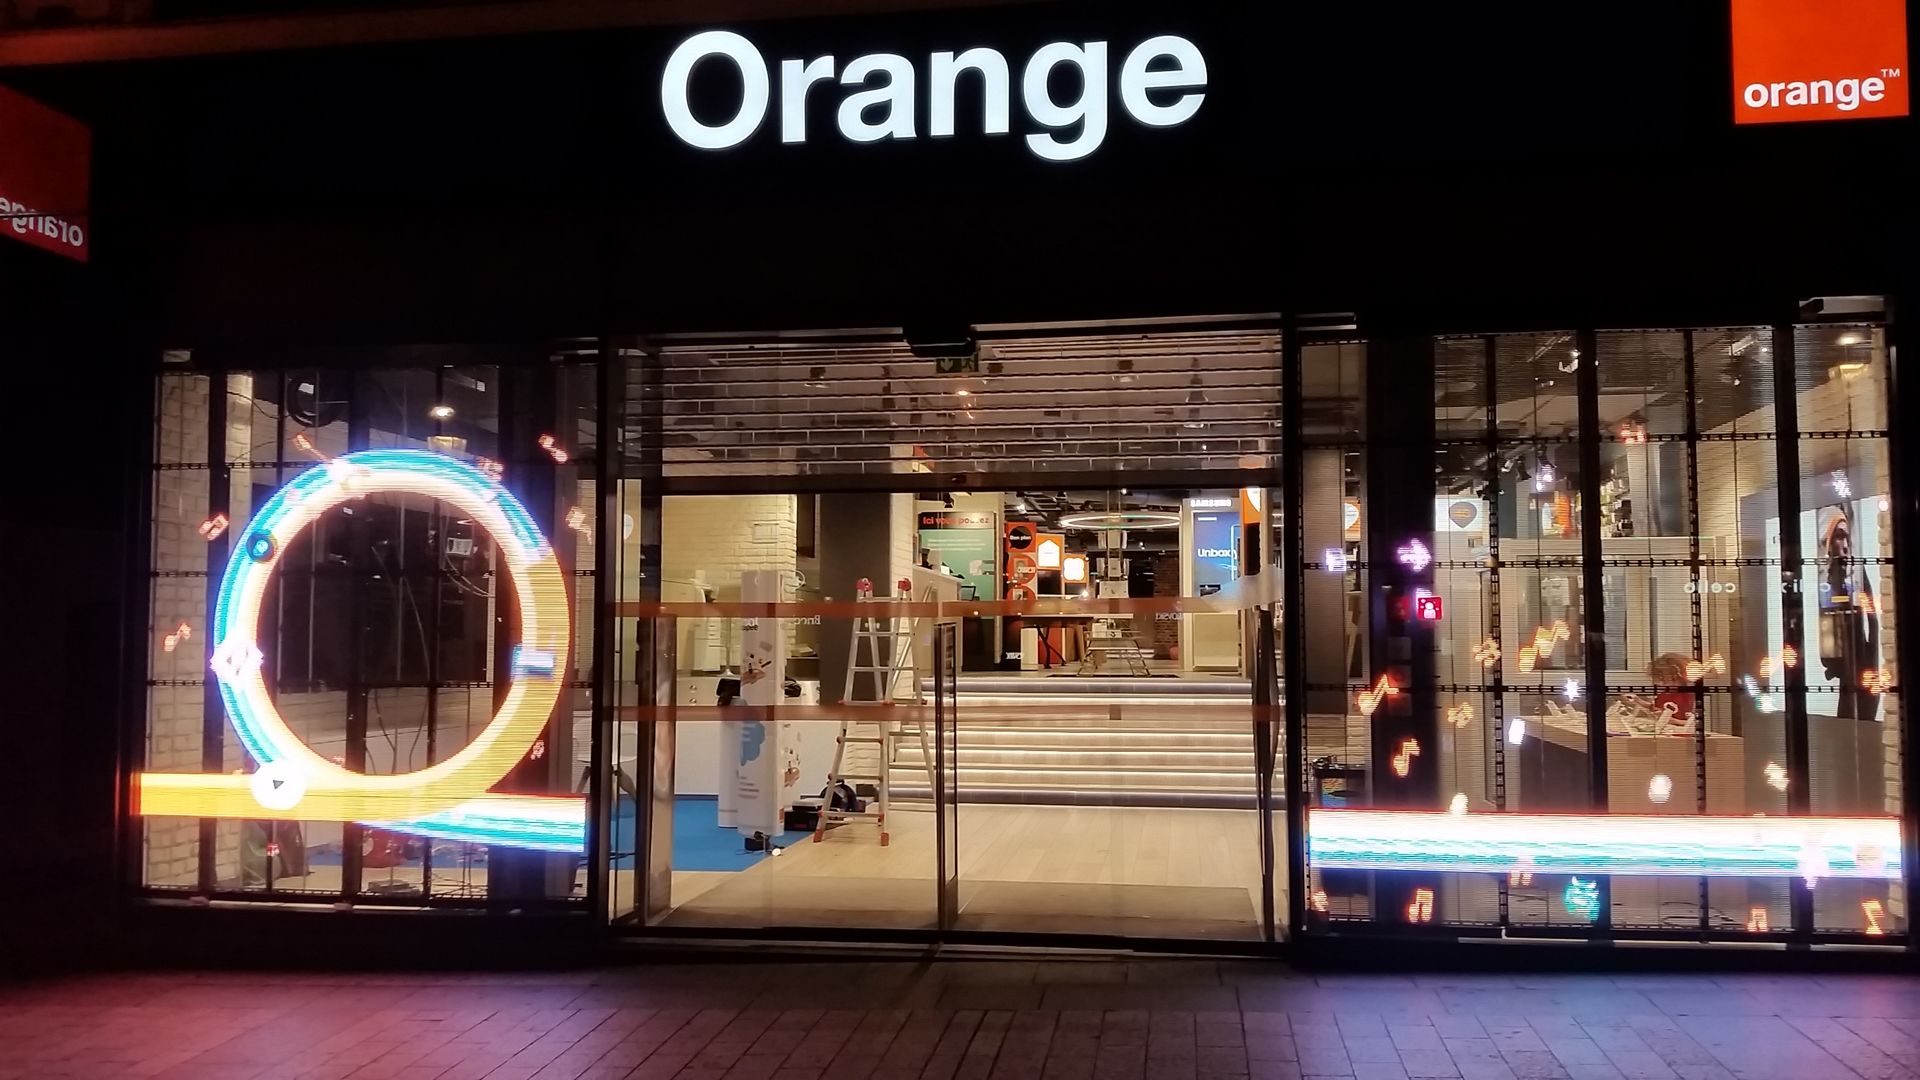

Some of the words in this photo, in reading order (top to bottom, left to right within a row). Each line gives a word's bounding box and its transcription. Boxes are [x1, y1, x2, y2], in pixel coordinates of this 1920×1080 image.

[661, 30, 1208, 162] Orange
[923, 516, 934, 525] Ici
[960, 517, 989, 526] poez
